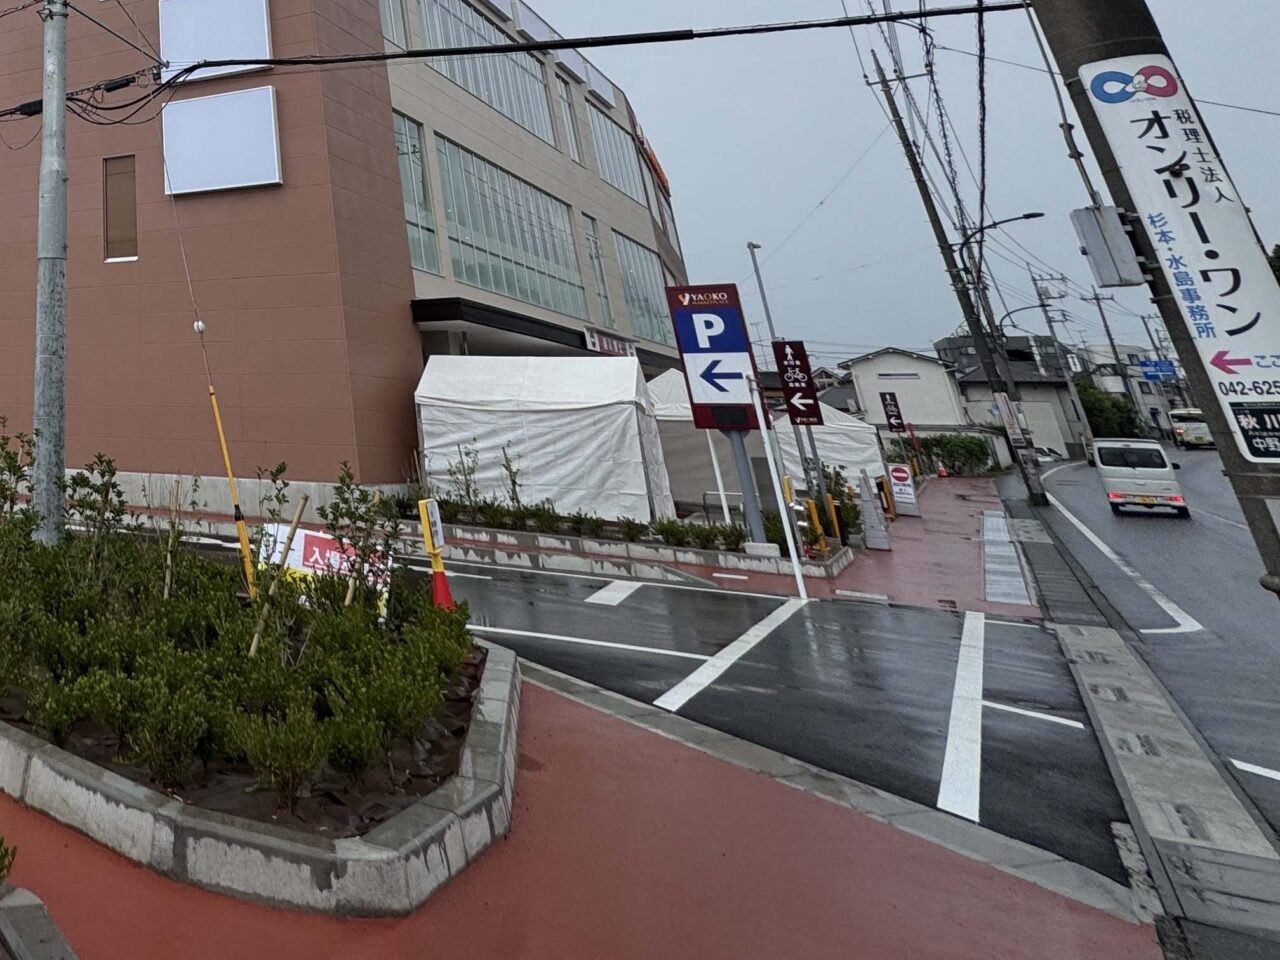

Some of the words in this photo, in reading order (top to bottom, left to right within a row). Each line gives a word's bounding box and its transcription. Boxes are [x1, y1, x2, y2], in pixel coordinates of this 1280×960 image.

[1172, 108, 1235, 203] 税理士法人
[1130, 110, 1261, 337] オンリー・ワン
[691, 292, 728, 301] YAOKO
[1147, 212, 1217, 338] 杉本・水島事務所
[691, 313, 725, 348] P
